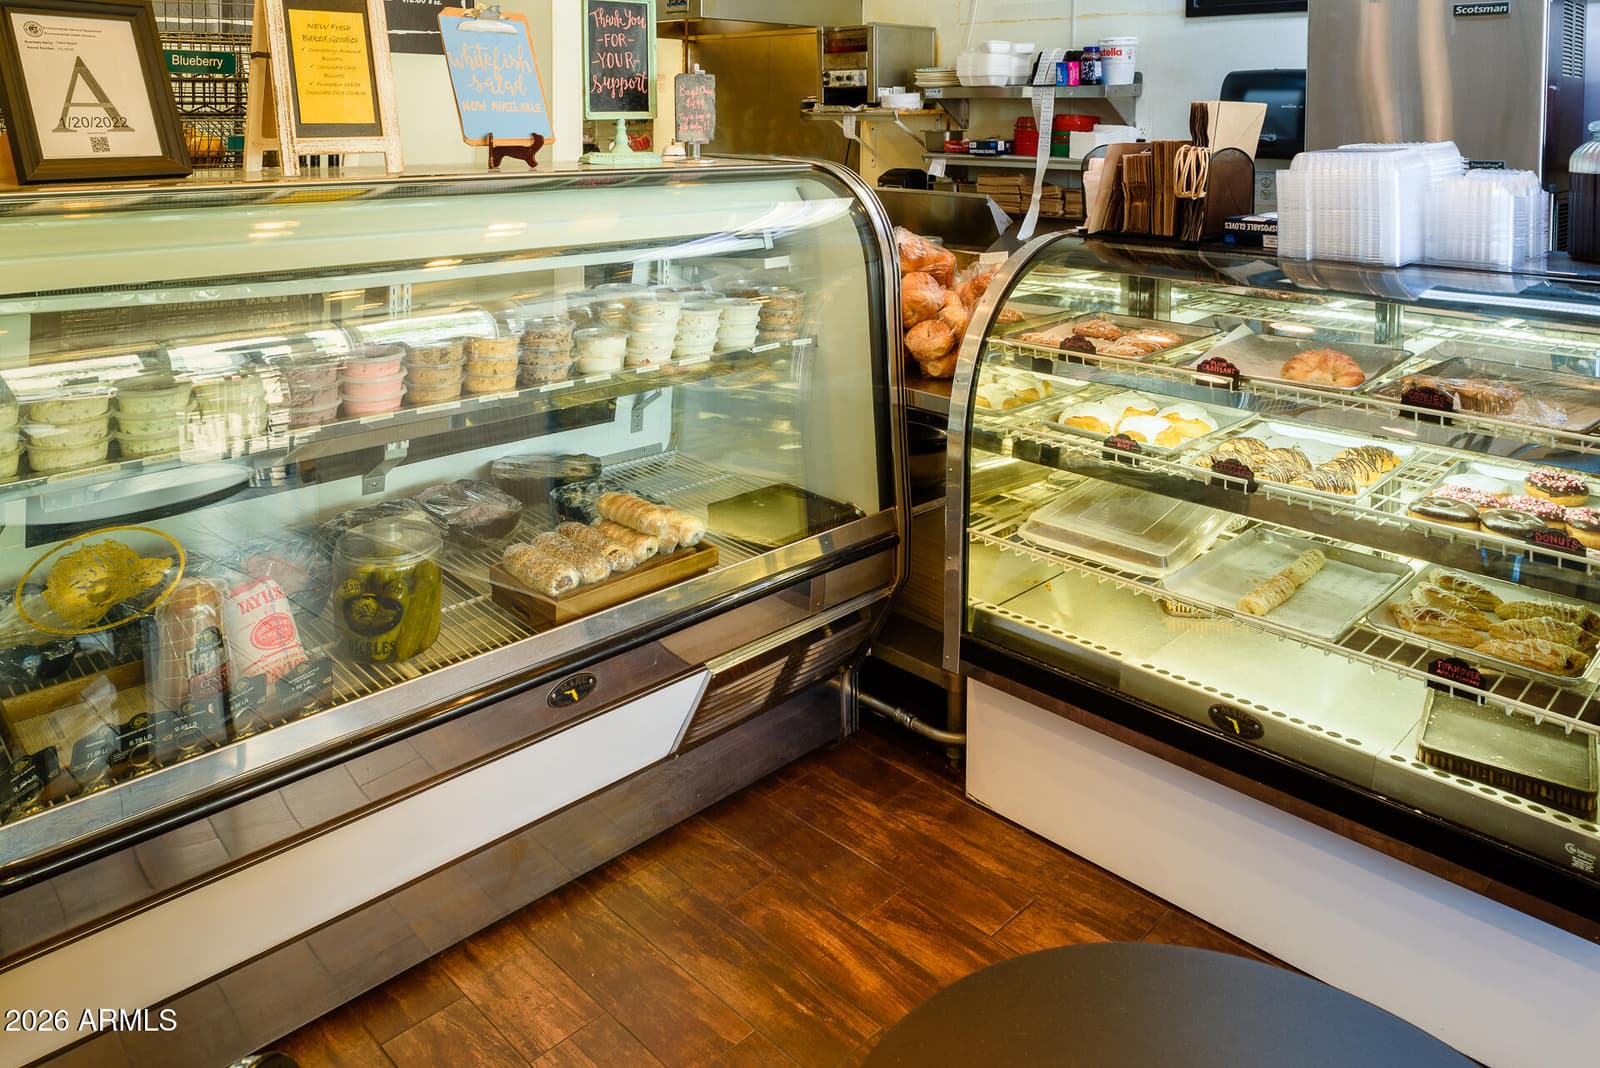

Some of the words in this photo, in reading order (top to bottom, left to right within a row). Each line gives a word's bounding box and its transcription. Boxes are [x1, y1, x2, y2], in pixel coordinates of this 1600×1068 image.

[590, 7, 625, 28] Thank
[623, 8, 647, 30] You
[1455, 5, 1507, 14] Scotsman
[171, 54, 224, 70] Blueberry
[52, 56, 135, 133] A
[591, 71, 648, 99] support
[462, 101, 487, 112] NOW
[491, 101, 543, 112] AVAILABLE
[1535, 532, 1578, 551] DONUTS
[237, 586, 285, 616] TAYLOR
